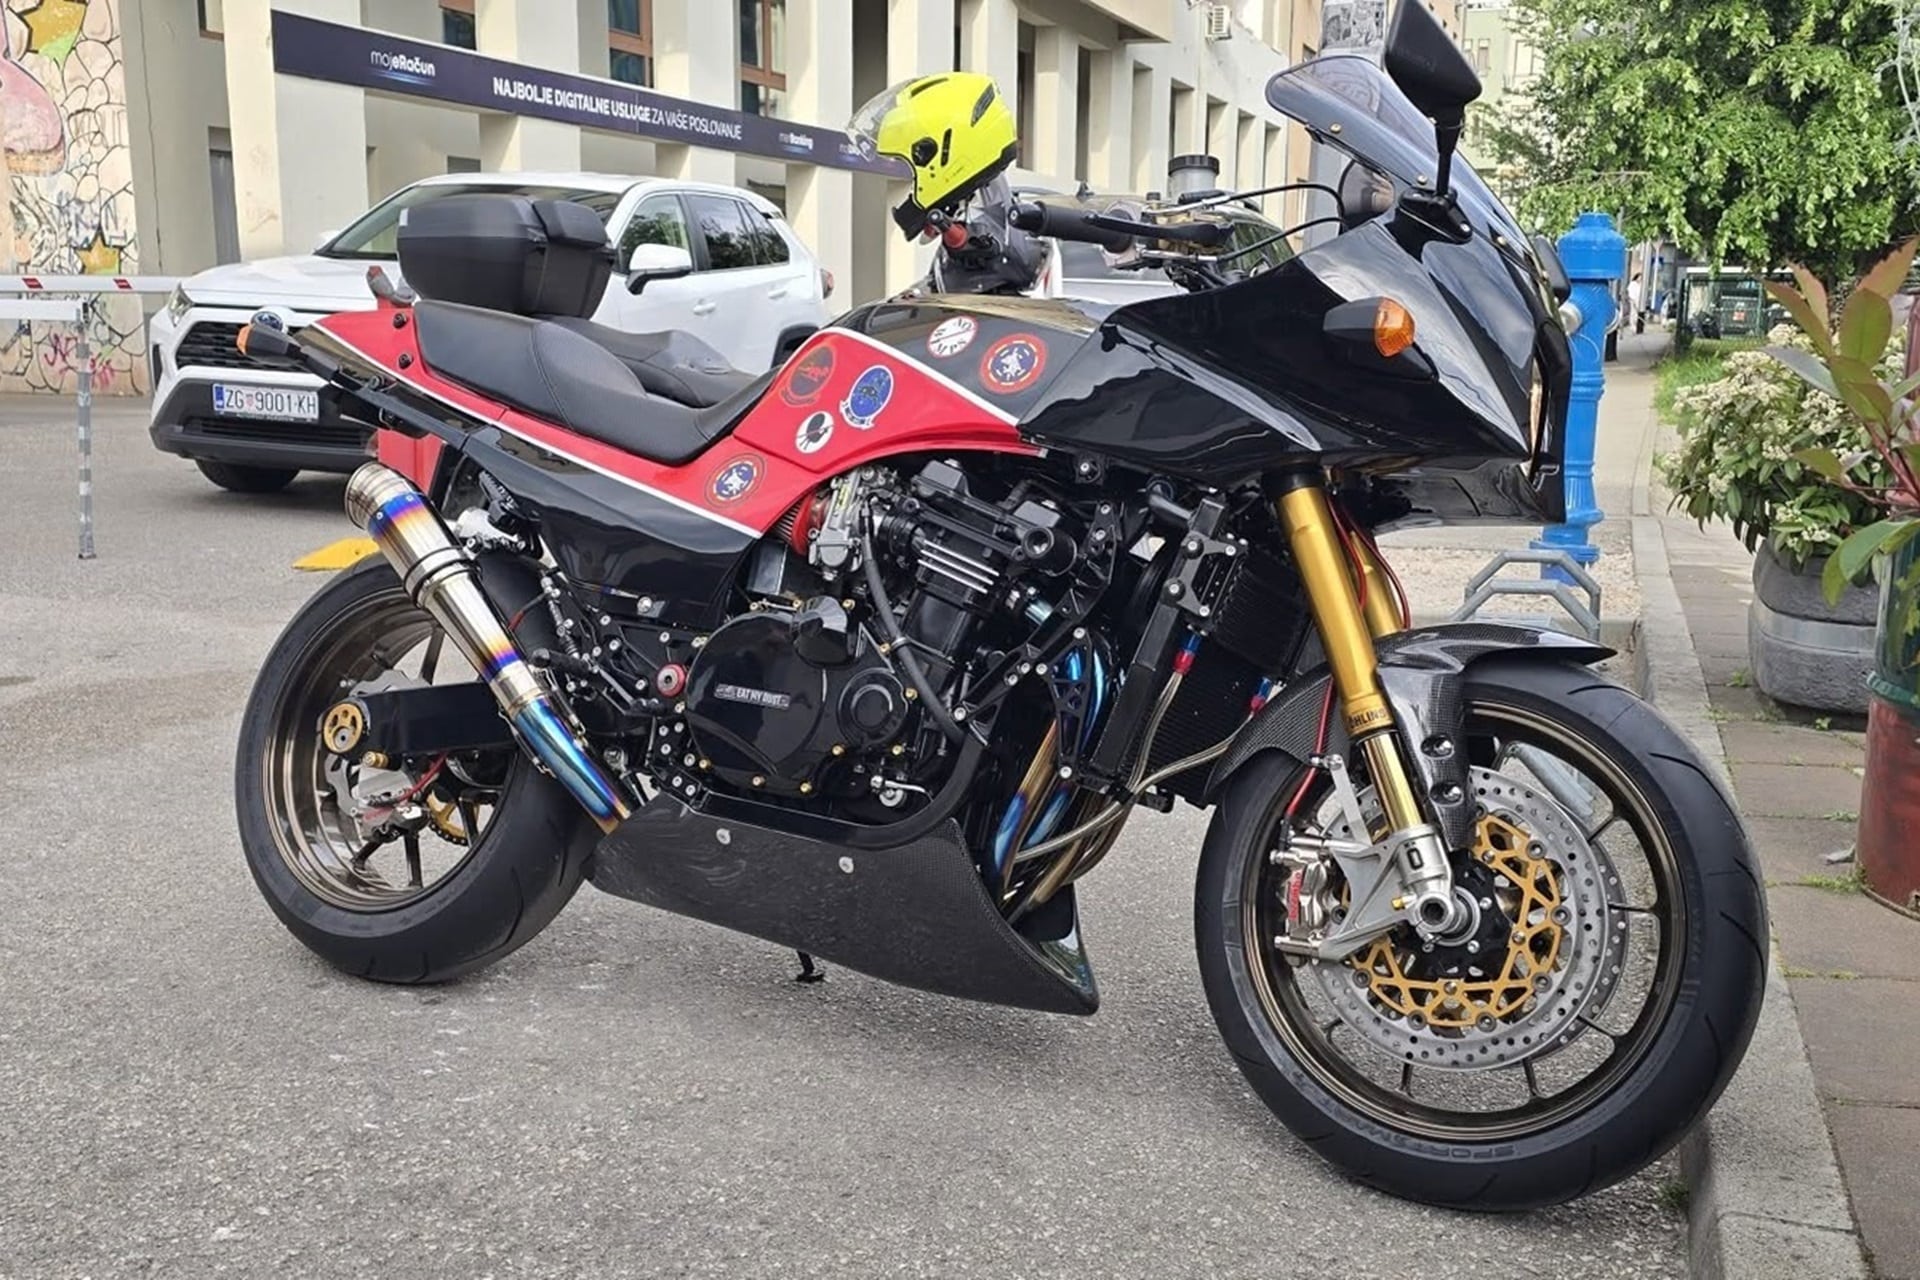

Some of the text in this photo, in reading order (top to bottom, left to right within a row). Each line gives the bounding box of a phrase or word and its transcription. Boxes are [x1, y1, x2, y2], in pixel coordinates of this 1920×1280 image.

[493, 77, 742, 140] NAJBOLJE DIGITALNE USLUGE ZA VAŠE POSLOVANJE
[225, 388, 245, 410] ZG
[737, 687, 750, 699] EAT
